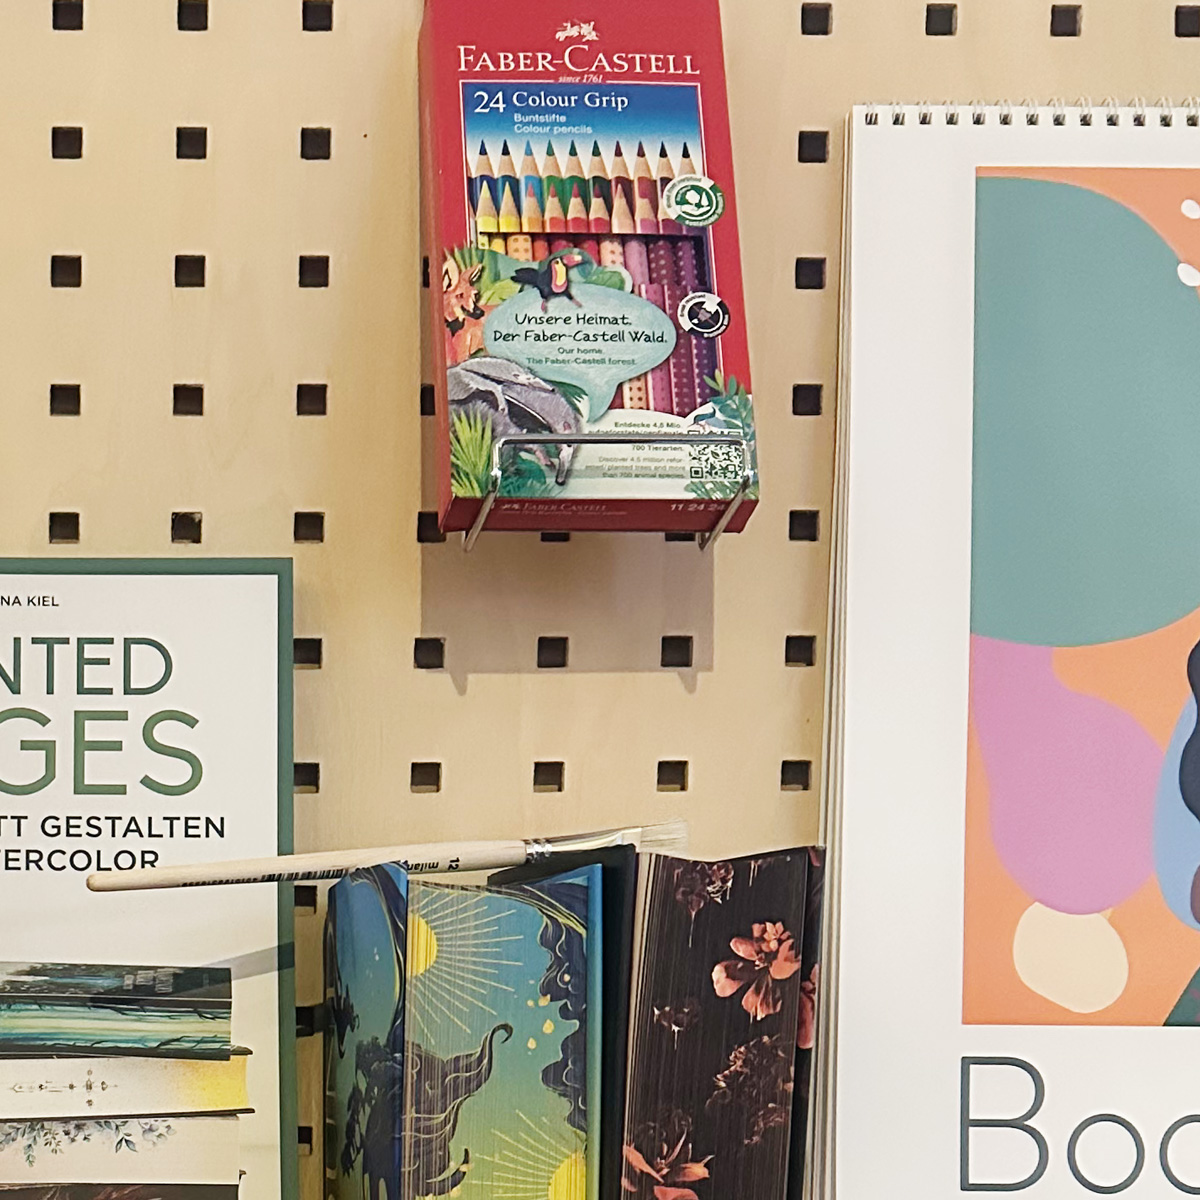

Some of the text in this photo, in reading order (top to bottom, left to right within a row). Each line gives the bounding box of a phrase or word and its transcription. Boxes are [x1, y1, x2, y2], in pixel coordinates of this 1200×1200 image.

[457, 44, 700, 75] FABER-CASTELL
[558, 74, 603, 83] since 1761
[474, 91, 629, 113] 24 Colour Grip
[514, 113, 567, 123] Buntstifte
[514, 124, 593, 135] Colour pencils
[515, 313, 632, 325] Unsere Heimat.
[493, 330, 668, 343] Der Faber-Castell Wald.
[544, 357, 606, 365] Faber-Castell
[27, 594, 60, 607] KIEL
[39, 814, 226, 839] GESTALTEN
